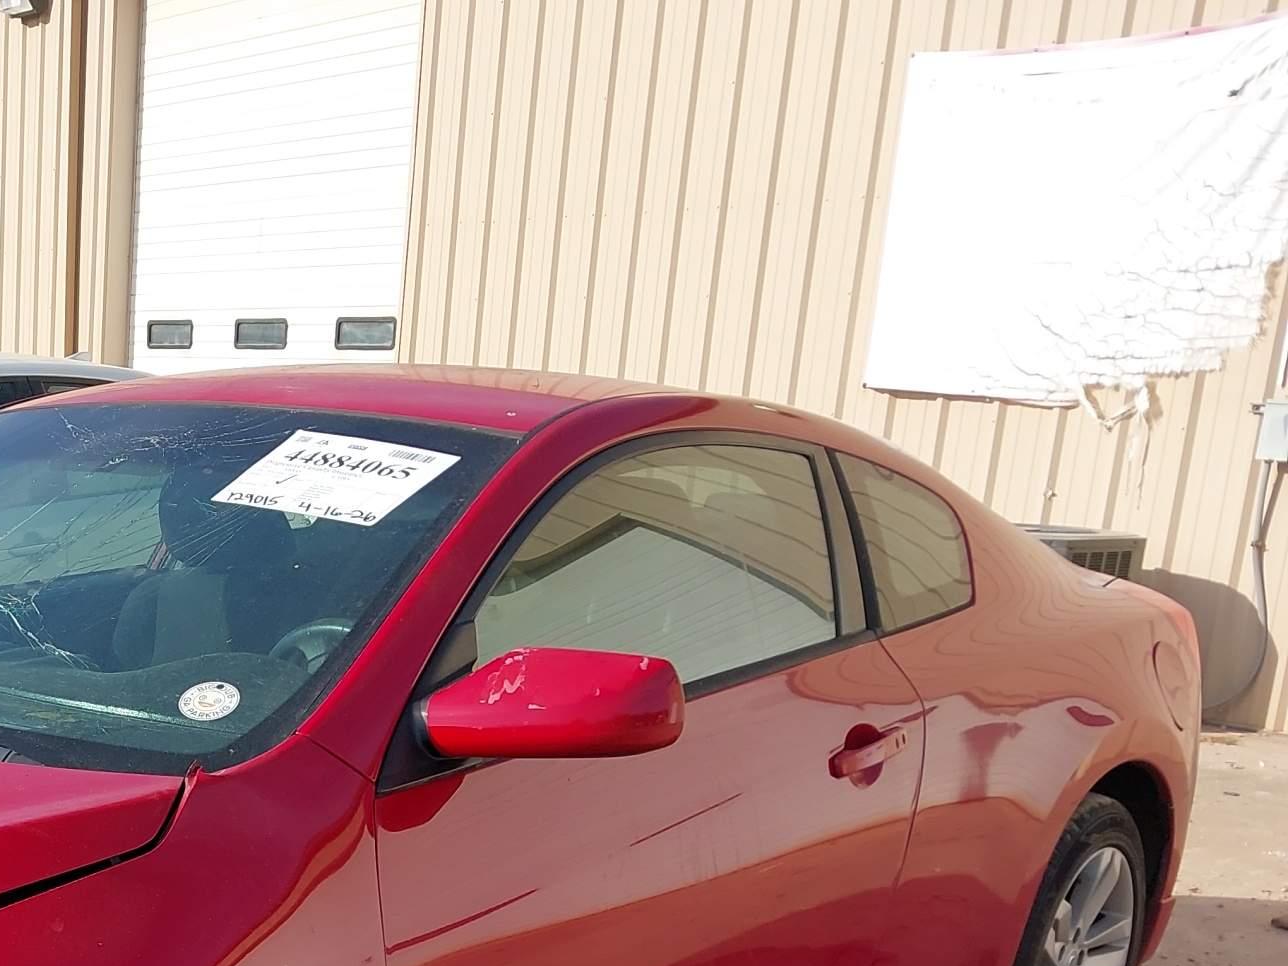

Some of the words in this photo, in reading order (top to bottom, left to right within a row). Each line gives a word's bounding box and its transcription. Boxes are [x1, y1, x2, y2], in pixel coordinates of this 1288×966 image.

[284, 449, 418, 479] 44884065
[298, 501, 376, 522] 4-16-26
[187, 705, 230, 719] PARKING
